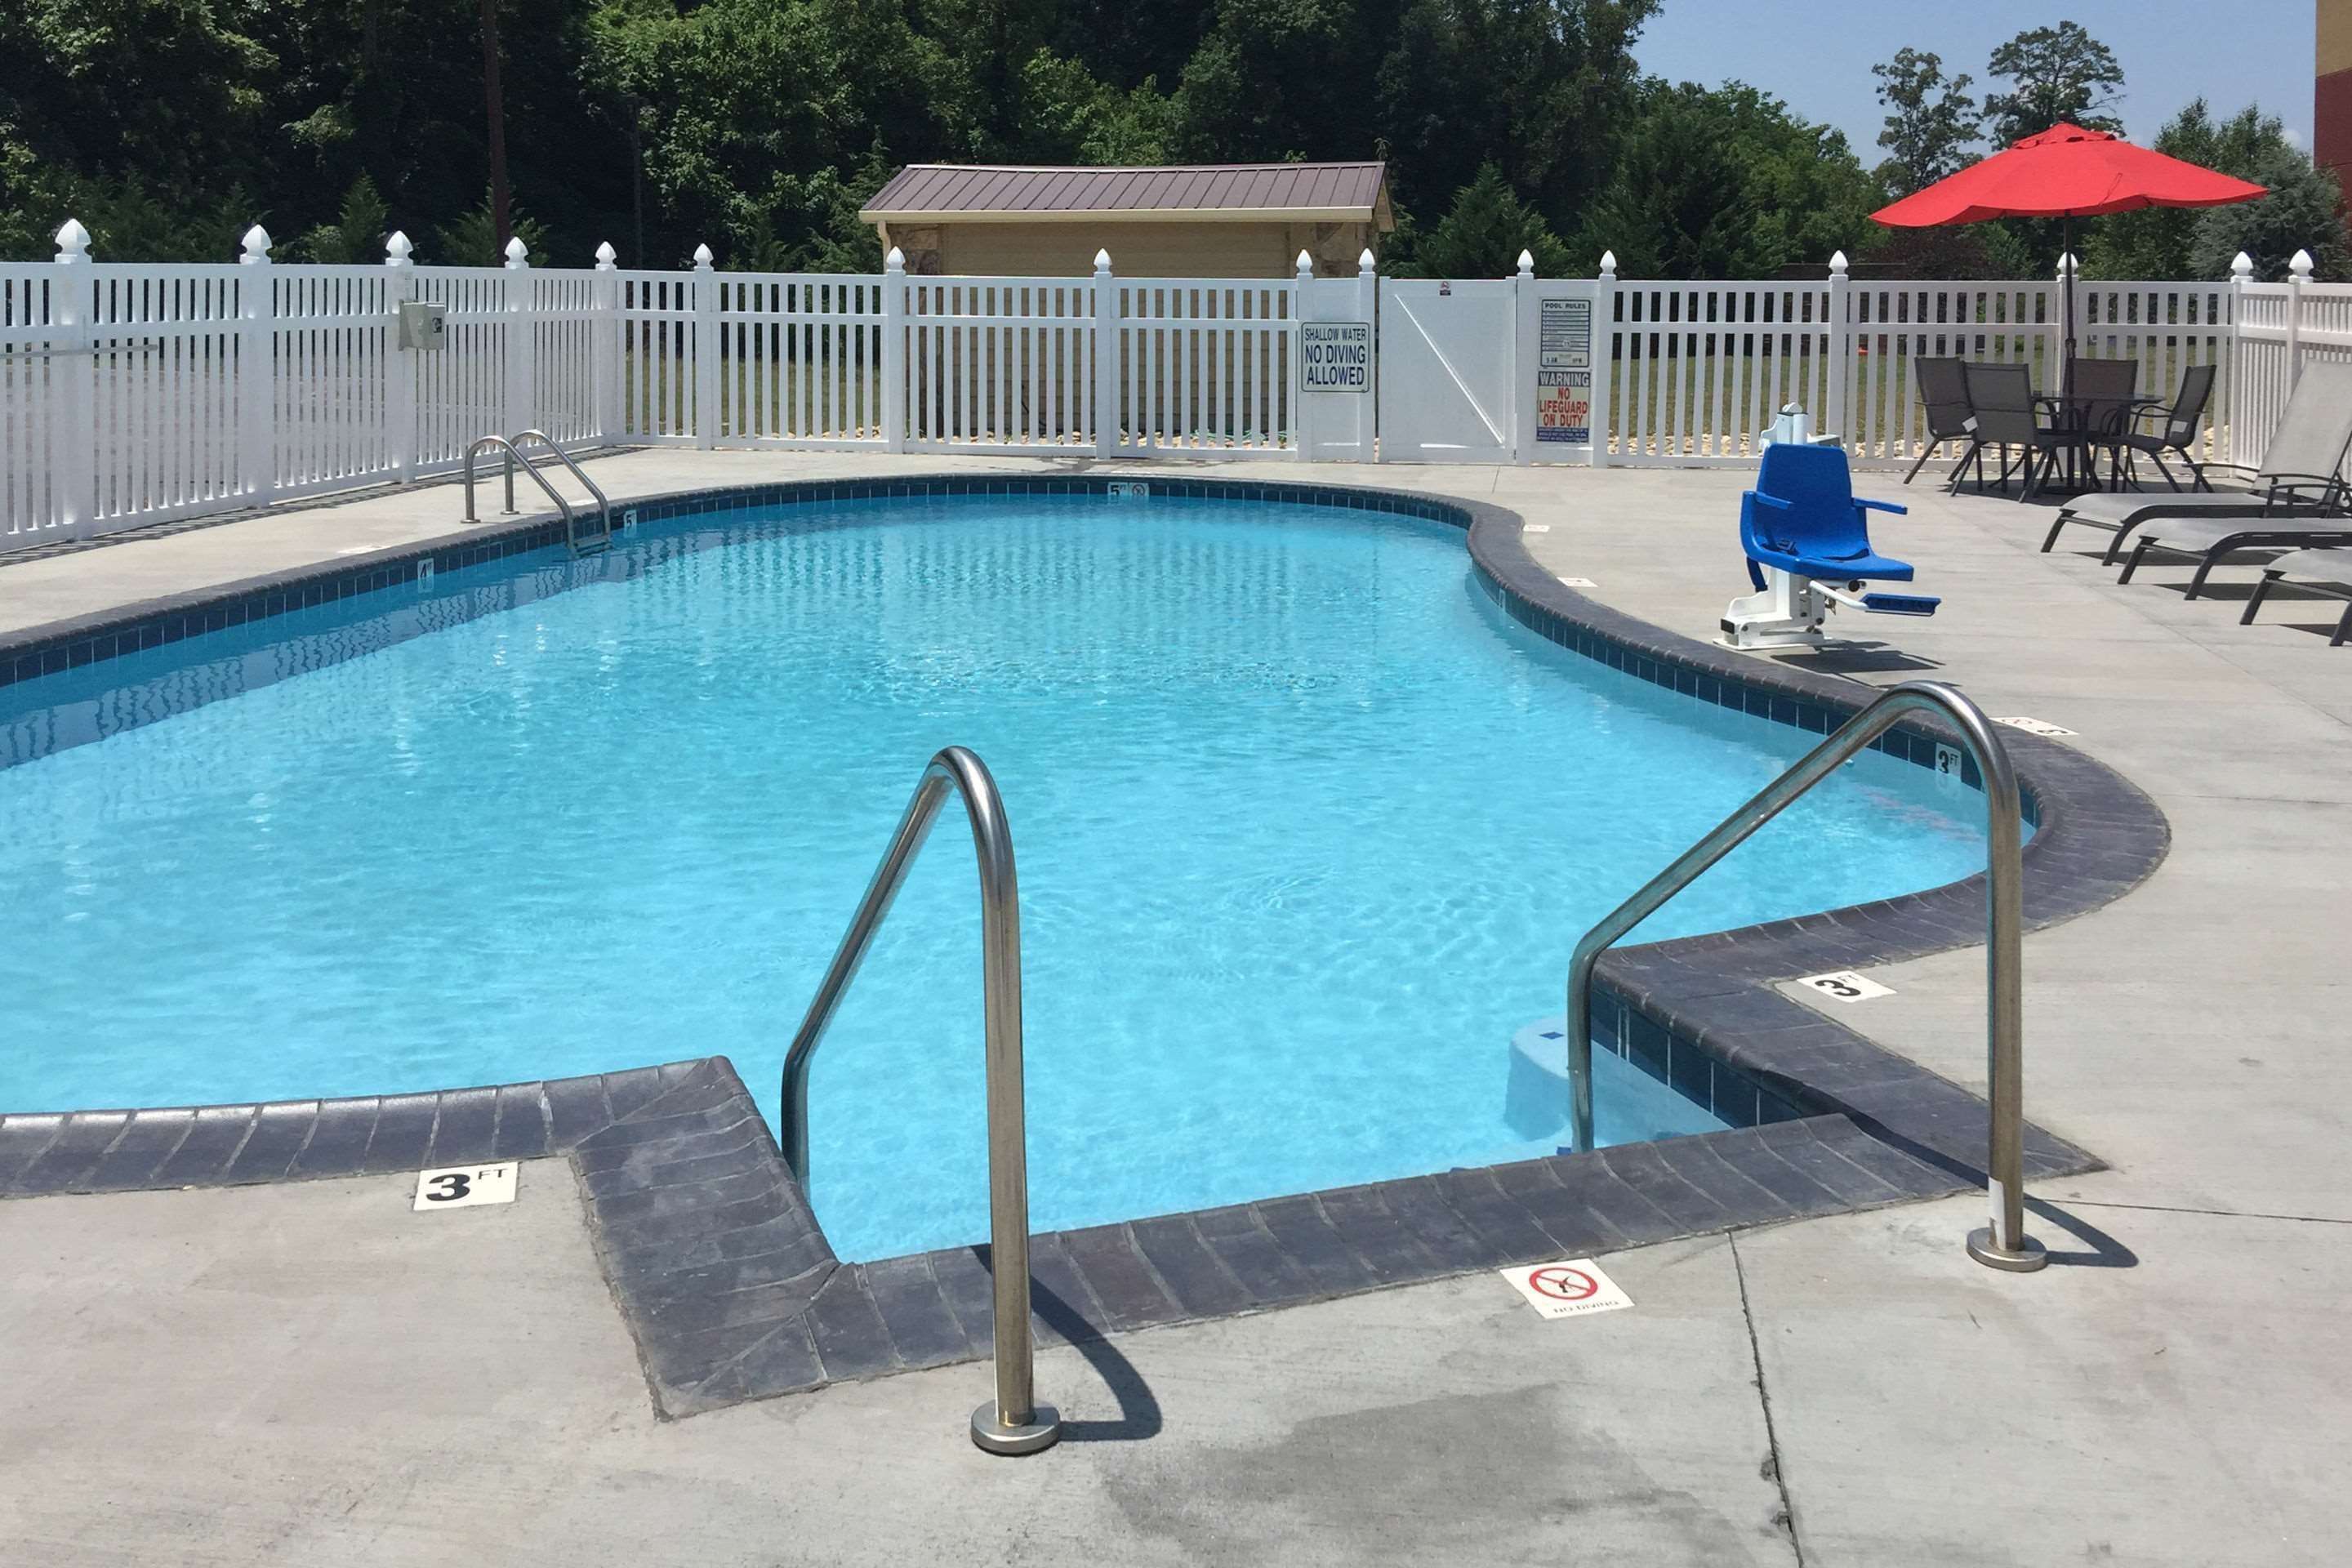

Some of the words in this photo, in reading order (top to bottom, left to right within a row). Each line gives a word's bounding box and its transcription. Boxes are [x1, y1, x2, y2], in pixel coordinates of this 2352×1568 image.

[1305, 327, 1339, 341] SHALLOW
[1341, 328, 1366, 341] WATER
[1305, 345, 1322, 363] NO
[1326, 345, 1365, 364] DIVING
[1307, 366, 1365, 385] ALLOWED
[1539, 372, 1589, 386] WARNING
[1557, 388, 1570, 400] NO
[1539, 399, 1588, 414] LIFEGUARD
[1543, 414, 1556, 426] ON
[1560, 414, 1583, 426] DUTY
[1111, 485, 1120, 497] 5
[1939, 750, 1949, 774] 3
[1949, 753, 1959, 766] FT
[1815, 979, 1861, 996] 3
[425, 1174, 471, 1201] 3
[477, 1168, 509, 1180] FT
